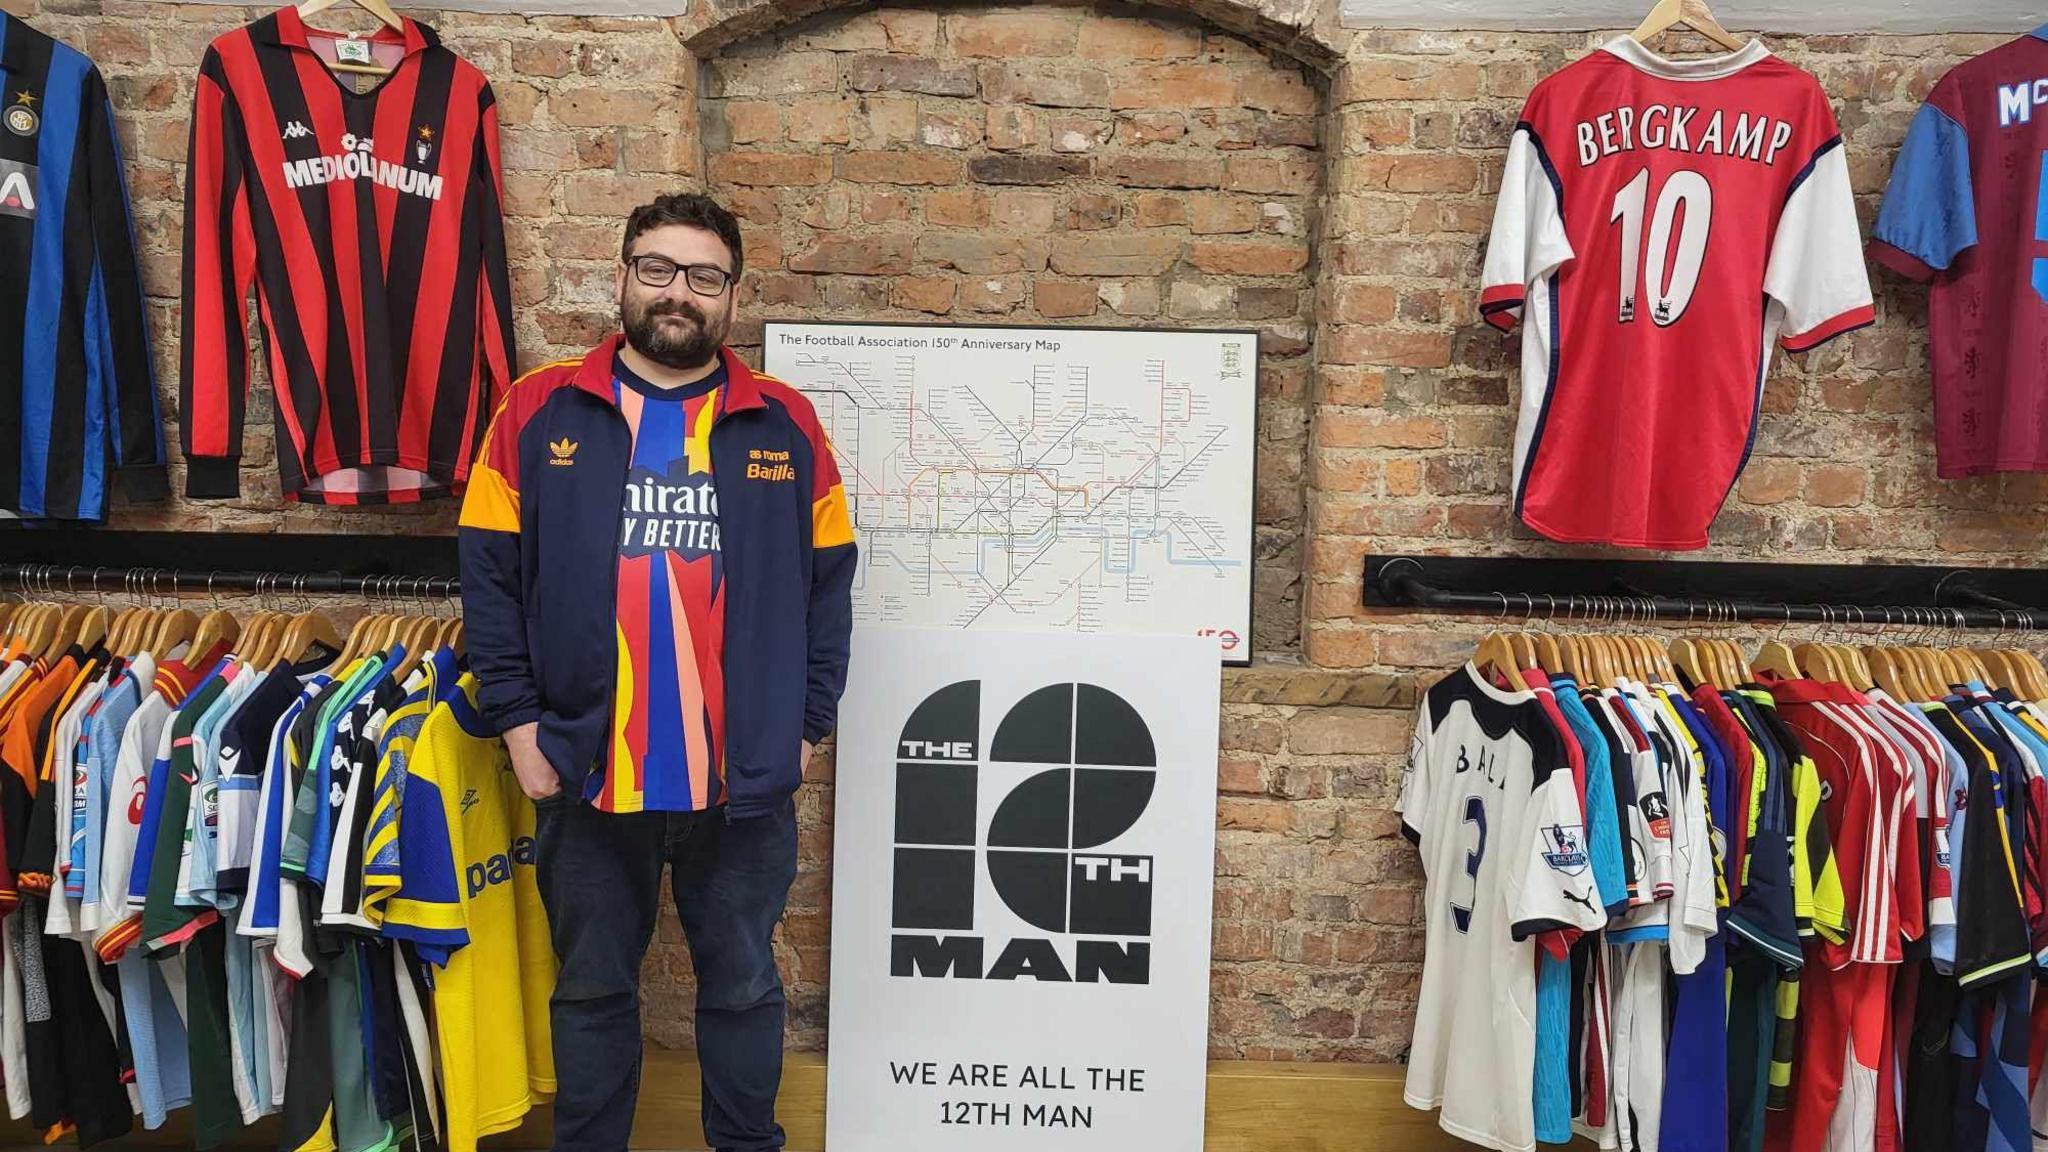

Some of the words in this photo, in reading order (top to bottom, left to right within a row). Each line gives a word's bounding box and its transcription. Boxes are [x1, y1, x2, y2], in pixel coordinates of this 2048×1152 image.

[1576, 104, 1793, 167] BERGKAMP
[282, 151, 444, 200] MEDIOLANUM
[1609, 165, 1713, 327] 10
[779, 334, 802, 346] The
[805, 335, 855, 347] Football
[857, 336, 928, 349] Association
[931, 338, 958, 349] 150th
[961, 338, 1031, 352] Anniversary
[1035, 340, 1061, 353] Map
[549, 457, 574, 466] adidas
[746, 463, 796, 481] Barilla
[643, 518, 721, 551] BETTER
[901, 740, 973, 759] THE
[1455, 744, 1506, 791] BAL
[1075, 857, 1151, 883] TH
[890, 933, 1152, 985] MAN
[889, 1061, 938, 1086] WE
[947, 1063, 1009, 1088] ARE
[1018, 1065, 1076, 1090] ALL
[1086, 1067, 1146, 1092] THE
[940, 1101, 1011, 1126] 12TH
[1022, 1104, 1093, 1129] MAN
